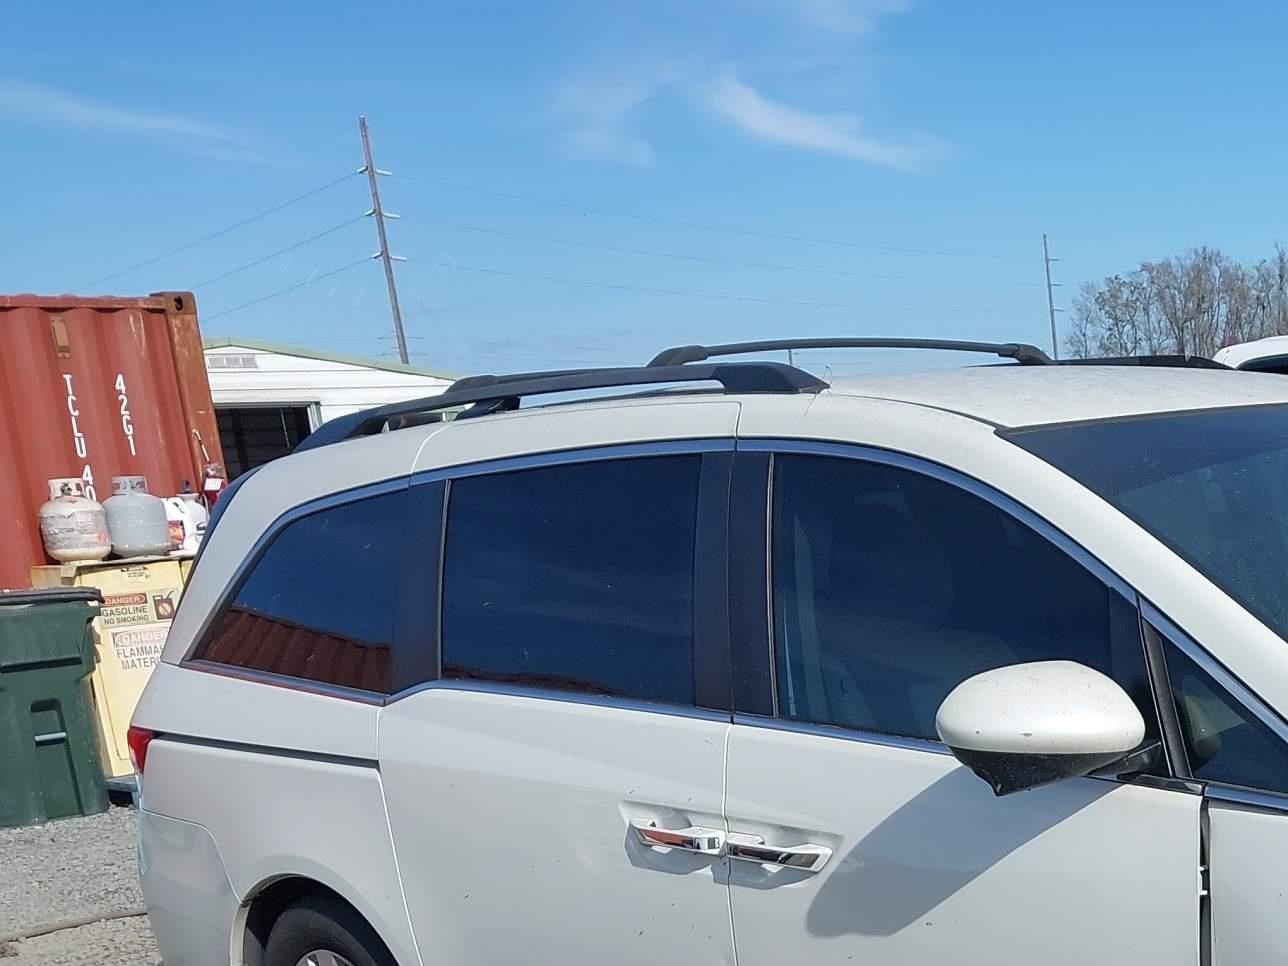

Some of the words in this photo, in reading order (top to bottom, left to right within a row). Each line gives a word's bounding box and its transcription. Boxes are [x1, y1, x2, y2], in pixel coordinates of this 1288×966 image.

[62, 374, 87, 458] TCLU
[115, 373, 136, 456] 42G1
[102, 606, 148, 617] GASOLINE
[116, 615, 149, 624] SMOKING
[116, 645, 163, 659] FLAMMA
